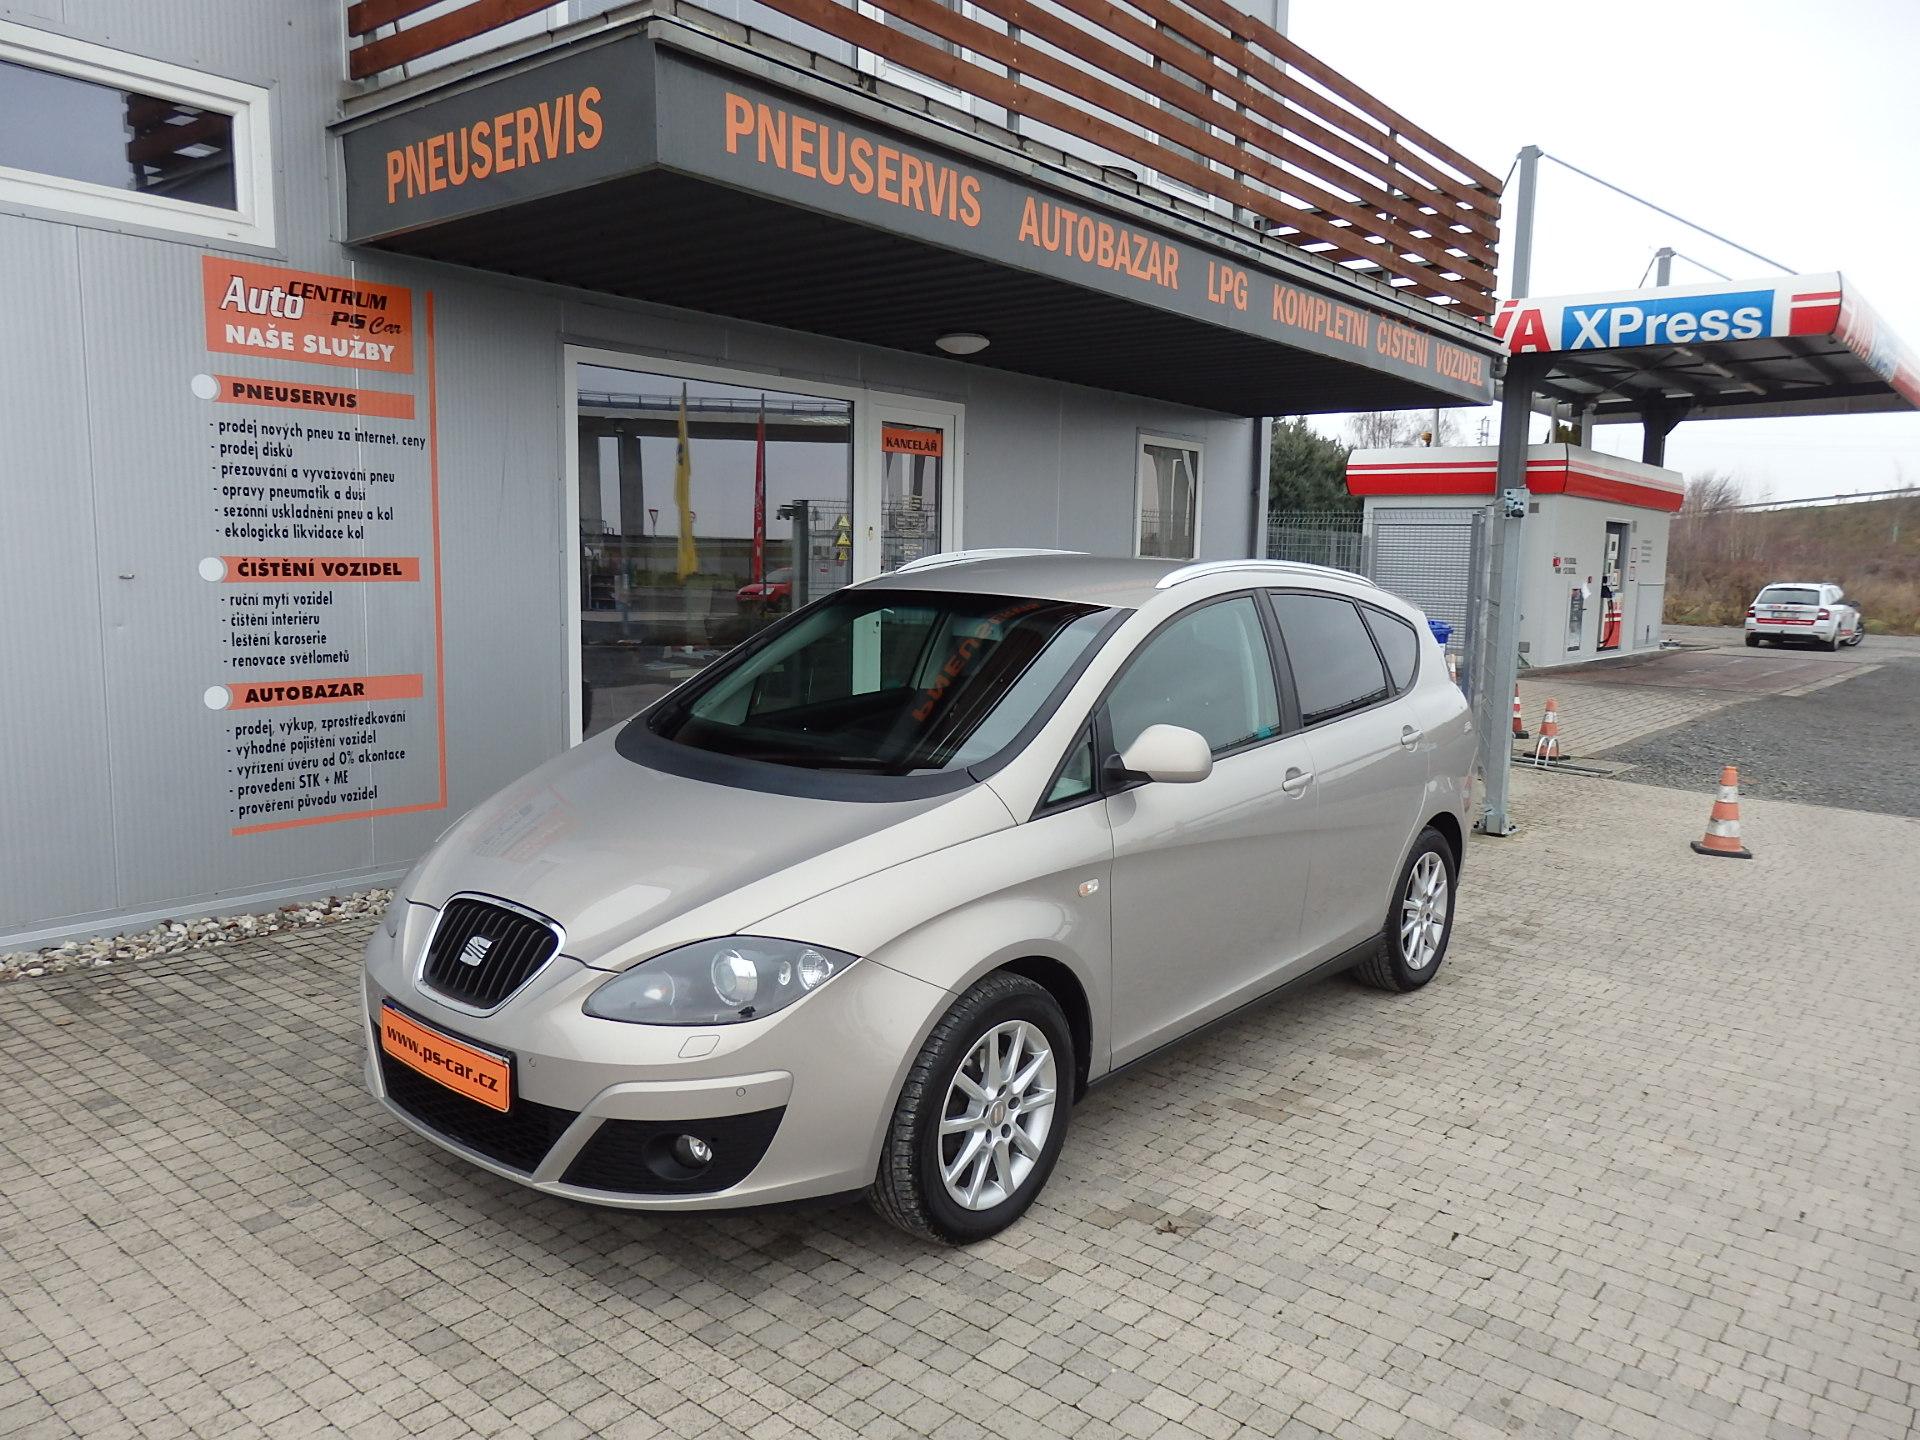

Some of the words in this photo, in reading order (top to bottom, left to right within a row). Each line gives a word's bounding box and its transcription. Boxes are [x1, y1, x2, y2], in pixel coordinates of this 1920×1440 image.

[387, 86, 603, 204] PNEUSERVIS
[725, 92, 982, 227] PNEUSERVIS
[1018, 196, 1180, 290] AUTOBAZAR
[1207, 260, 1249, 311] LPG
[1272, 281, 1371, 349] KOMPLETNÍ
[1376, 312, 1430, 368] ČIŠTĚNÍ
[1435, 342, 1483, 386] VOZIDEL
[219, 274, 305, 320] Auto
[288, 281, 388, 311] CENTRUM
[330, 311, 367, 330] PS
[368, 316, 402, 335] Car
[1570, 305, 1764, 350] XPress
[225, 323, 295, 351] NAŠE
[303, 335, 395, 363] SLUŽBY
[232, 383, 358, 408] PNEUSERVIS
[219, 418, 258, 438] prodej
[261, 422, 303, 440] nových
[307, 428, 334, 441] pneu
[338, 431, 350, 441] za
[355, 427, 399, 445] internet.
[401, 436, 426, 450] ceny
[886, 437, 938, 452] KANCELÁŘ
[220, 440, 259, 459] prodej
[221, 461, 287, 478] přezouvání
[291, 469, 298, 478] a
[303, 467, 366, 482] vyvažování
[370, 472, 395, 485] pneu
[222, 486, 264, 500] opravy
[269, 485, 330, 501] pneumatik
[334, 490, 341, 499] a
[224, 503, 268, 517] sezónní
[272, 503, 334, 519] uskladnění
[337, 510, 363, 523] pneu
[366, 511, 373, 519] a
[377, 506, 394, 520] kol
[225, 522, 289, 542] ekologická
[293, 523, 344, 539] likvidace
[347, 524, 364, 540] kol
[237, 558, 315, 577] ČIŠTĚNÍ
[321, 562, 402, 577] VOZIDEL
[230, 592, 259, 606] ruční
[293, 590, 333, 605] vozidel
[231, 612, 268, 626] čištění
[272, 611, 320, 626] interiéru
[231, 631, 270, 647] leštění
[274, 630, 327, 646] karoserie
[232, 655, 286, 667] renovace
[290, 650, 349, 665] světlometů
[245, 682, 365, 703] AUTOBAZAR
[235, 719, 275, 740] prodej,
[321, 710, 406, 731] zprostředkování
[236, 739, 286, 759] výhodné
[290, 734, 336, 754] pojištění
[339, 730, 376, 746] vozidel
[237, 759, 284, 779] vyřízení
[288, 757, 319, 771] úvěru
[322, 752, 335, 767] od
[339, 750, 355, 765] 0%
[358, 749, 406, 763] akontace
[238, 777, 295, 799] provedení
[299, 773, 321, 788] STK
[334, 770, 348, 785] ME
[239, 796, 294, 820] prověření
[298, 791, 337, 811] původu
[340, 785, 378, 802] vozidel
[387, 1025, 498, 1092] www.ps-car.cz
